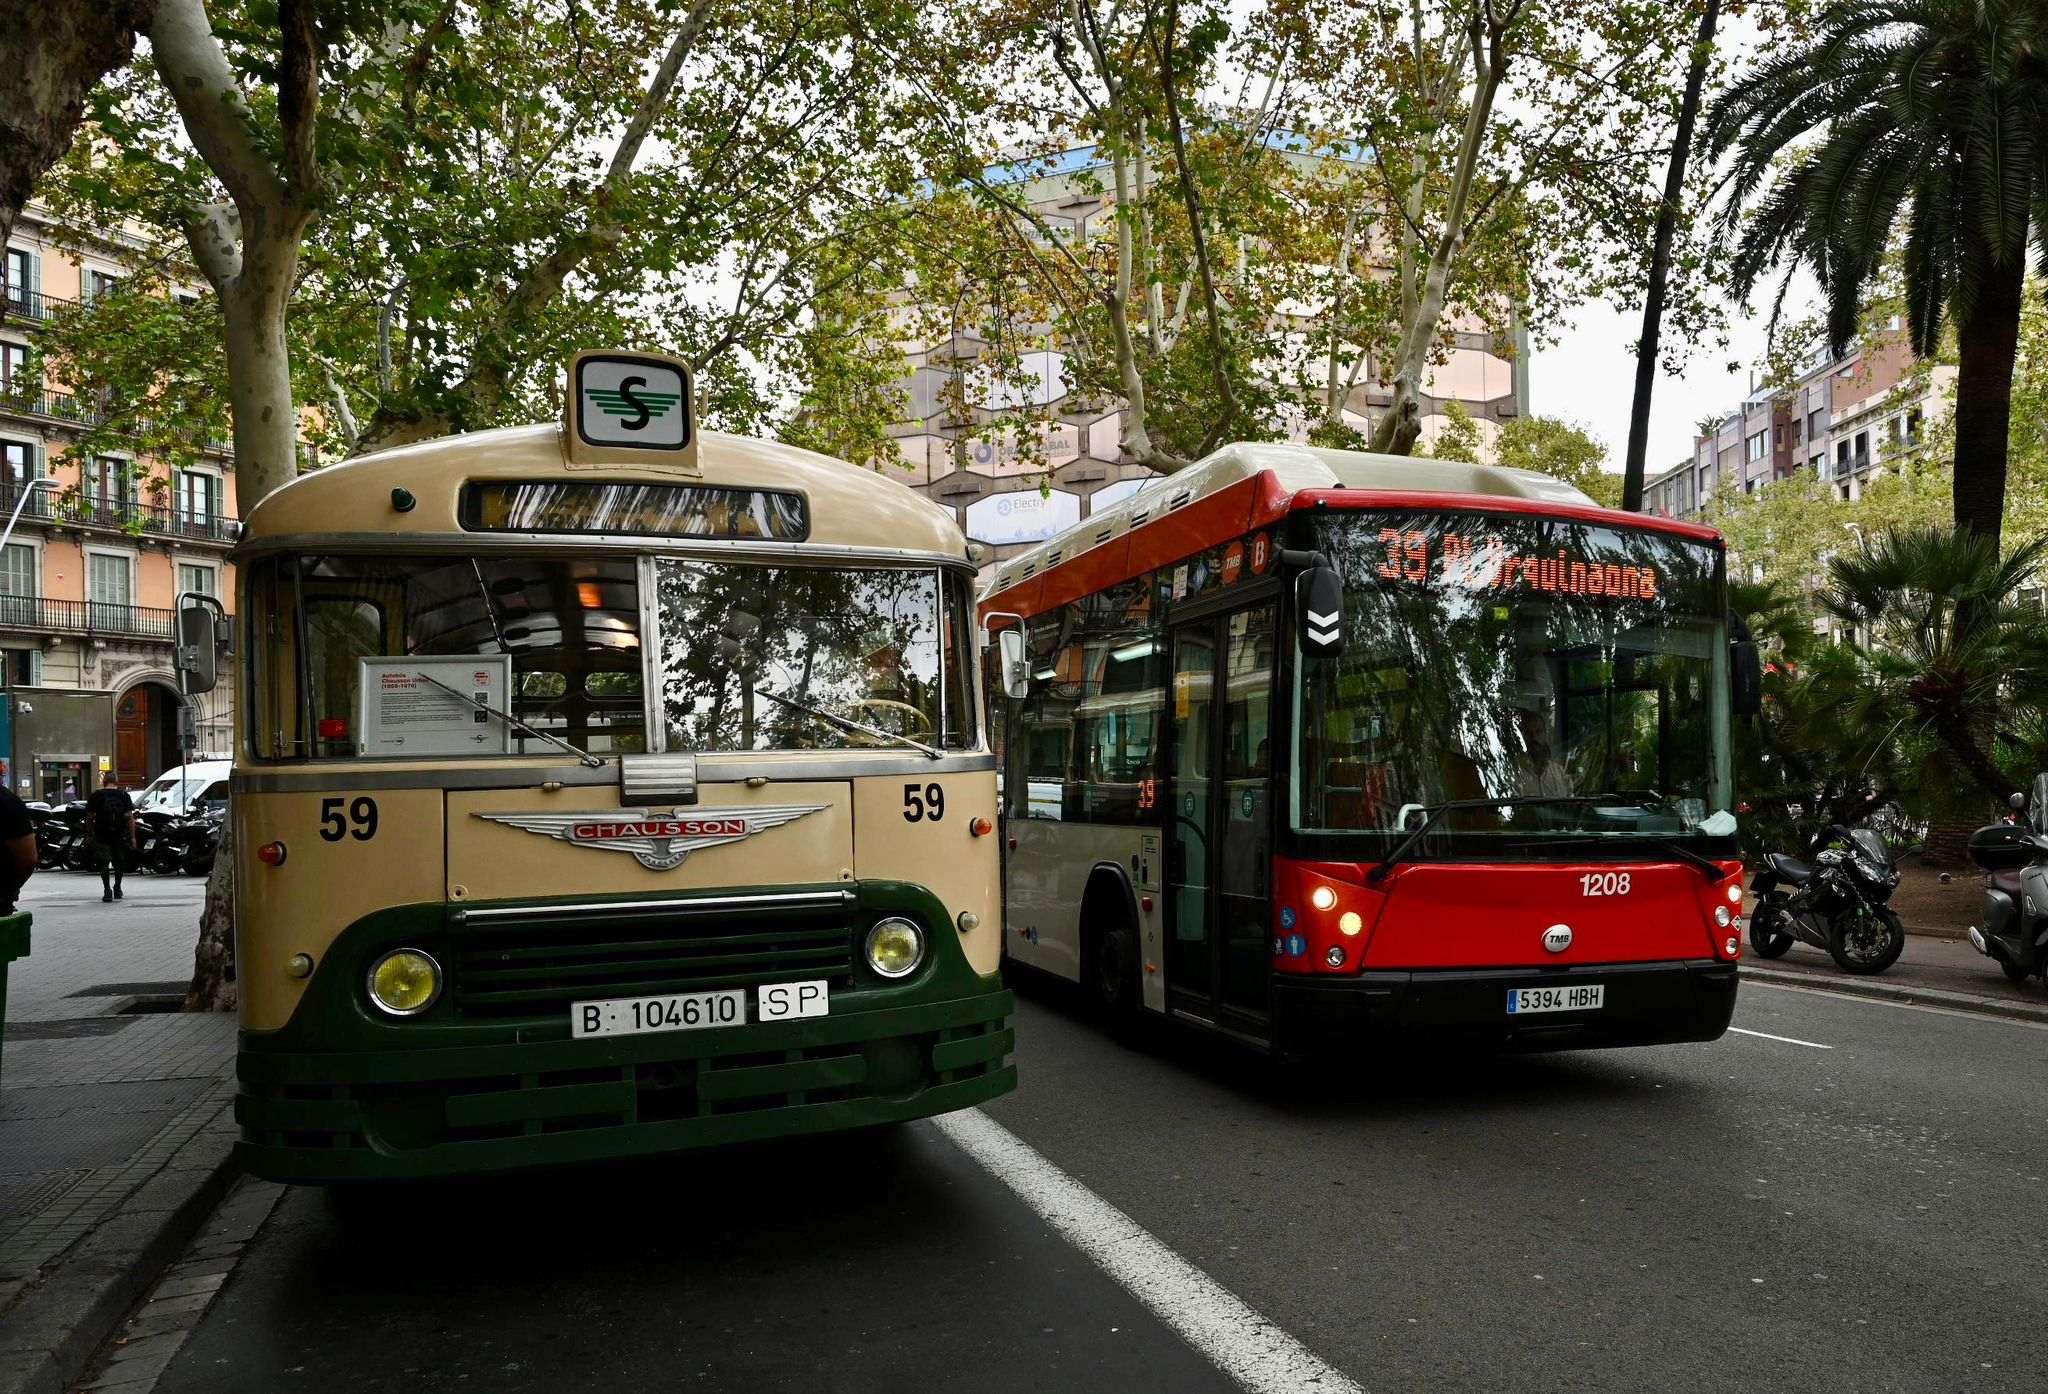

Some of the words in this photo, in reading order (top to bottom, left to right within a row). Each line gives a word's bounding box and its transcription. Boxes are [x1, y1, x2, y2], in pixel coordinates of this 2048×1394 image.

[620, 376, 650, 430] S
[1378, 528, 1426, 581] 39
[319, 796, 378, 842] 59
[903, 783, 945, 823] 59
[575, 820, 744, 838] CHAUSSON
[1579, 872, 1631, 897] 1208
[1550, 934, 1570, 944] TMB
[1520, 990, 1562, 1009] 5394
[1568, 987, 1599, 1007] HBH
